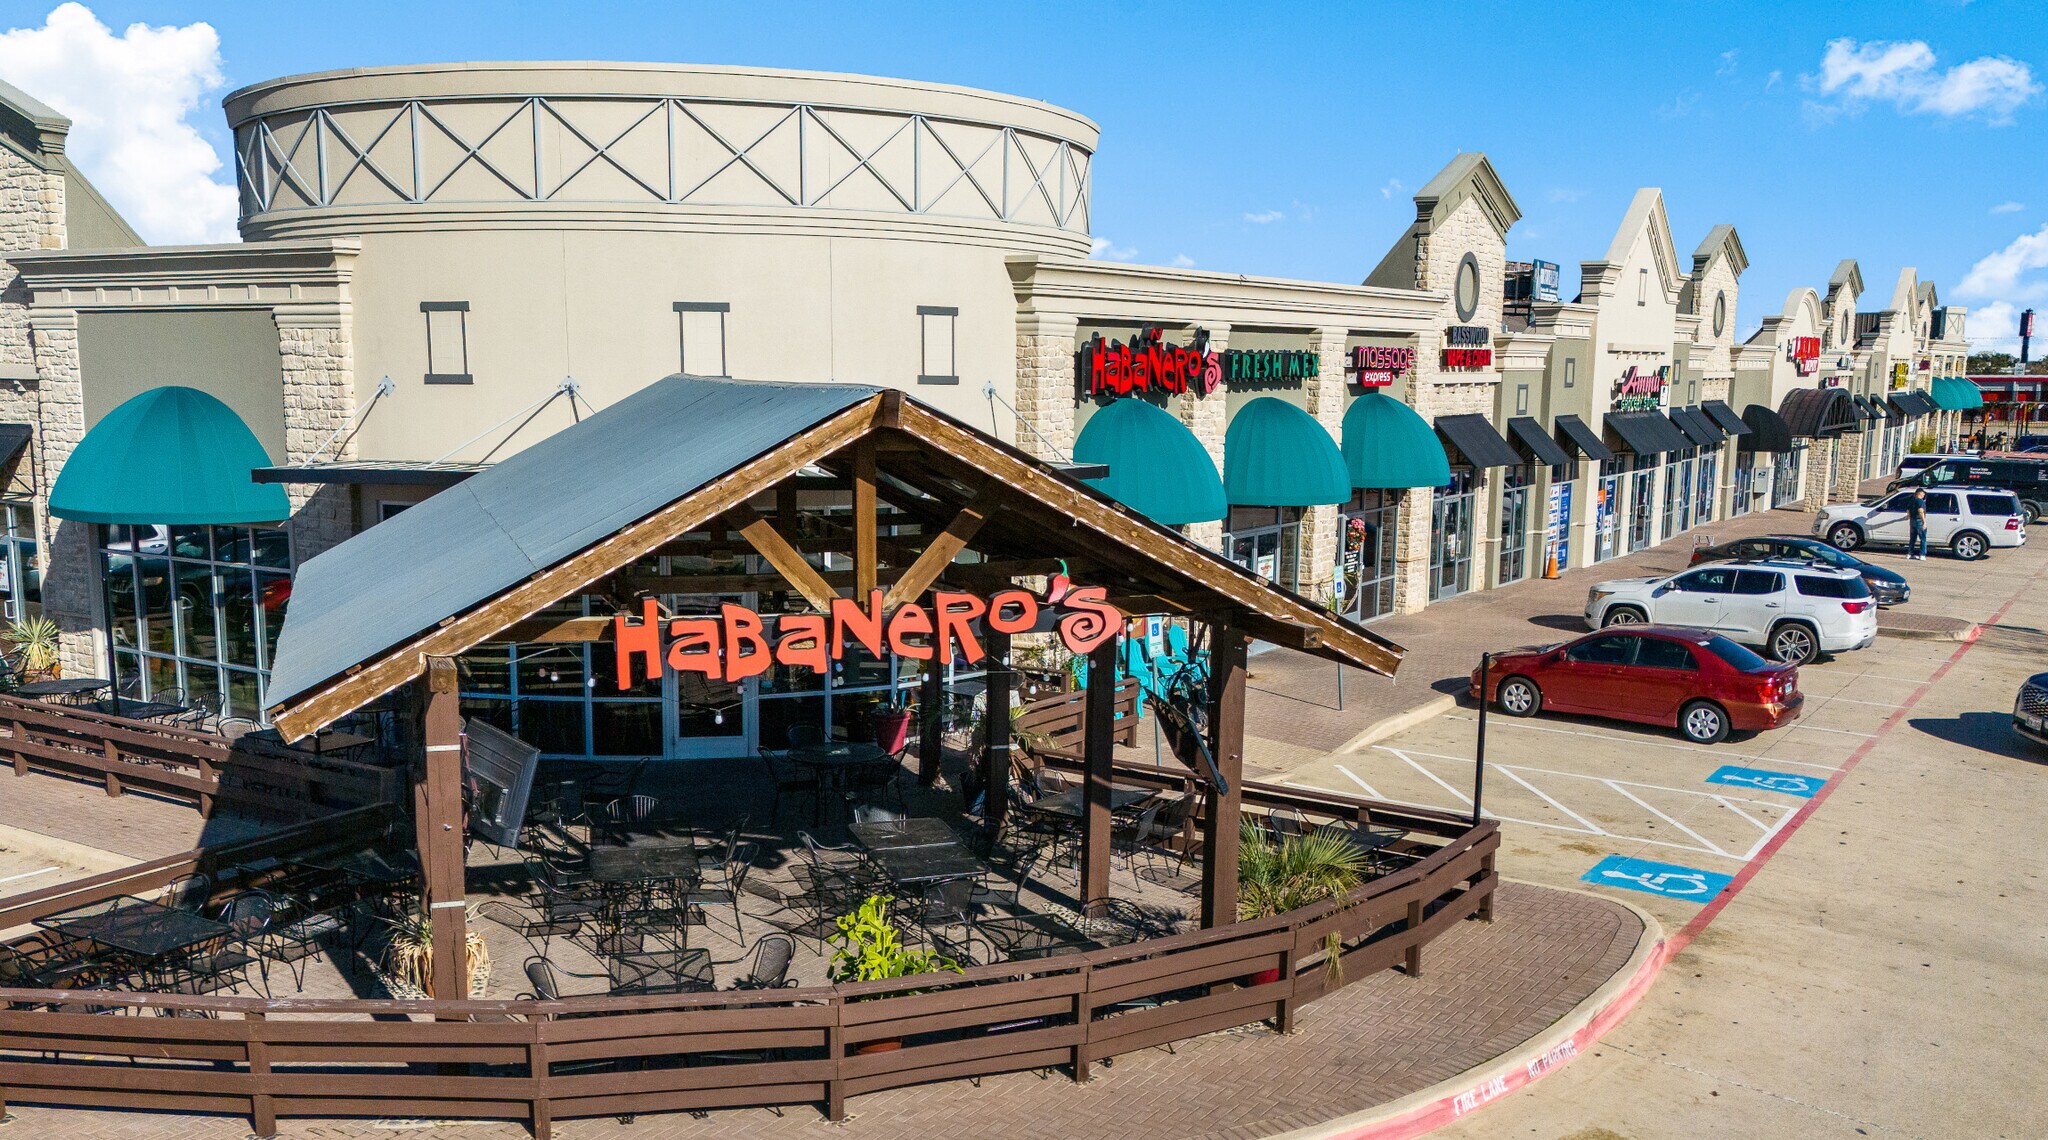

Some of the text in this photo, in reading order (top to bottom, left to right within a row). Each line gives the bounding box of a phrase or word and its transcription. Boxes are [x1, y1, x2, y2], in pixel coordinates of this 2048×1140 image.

[1452, 326, 1489, 344] BASSWOOD
[1231, 353, 1319, 379] FRESH MEX
[1357, 345, 1414, 375] massage
[1364, 371, 1391, 384] express
[1453, 1040, 1577, 1116] FIRE LANE NO PARKING
